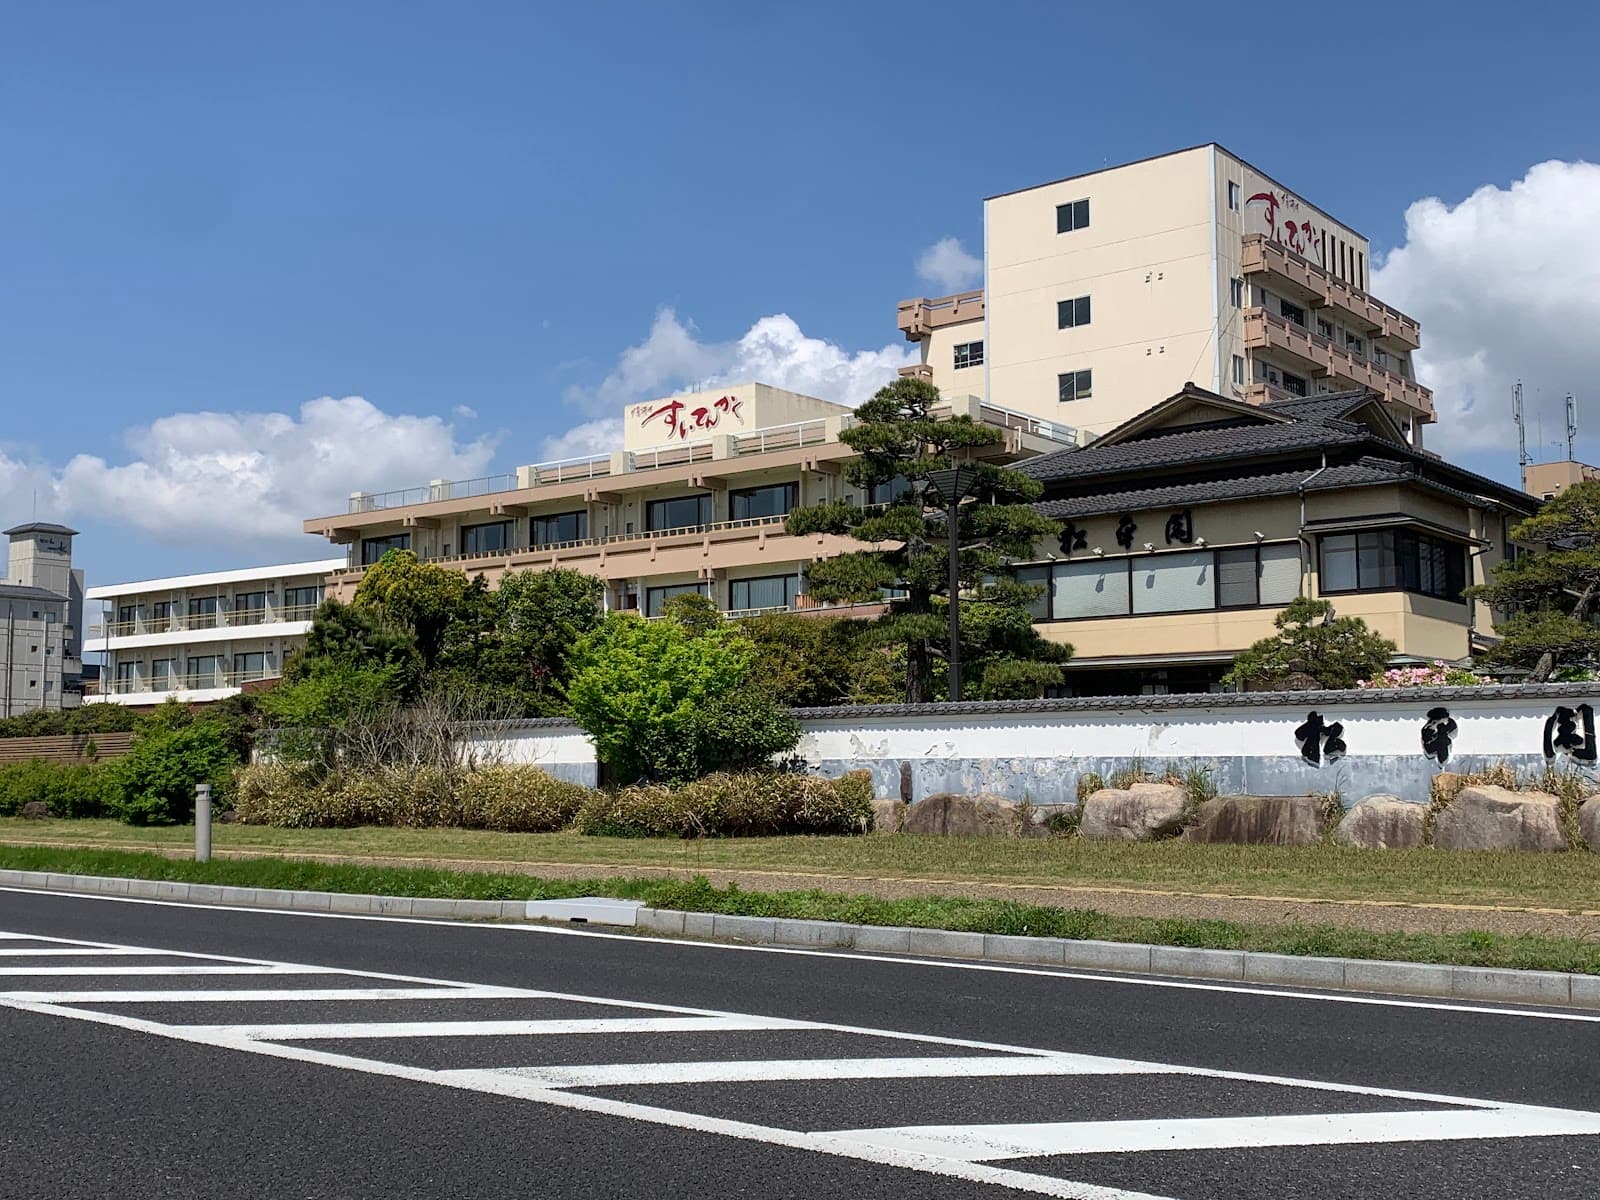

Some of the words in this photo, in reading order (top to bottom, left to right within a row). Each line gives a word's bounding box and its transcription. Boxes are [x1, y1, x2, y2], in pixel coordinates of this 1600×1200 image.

[641, 396, 744, 439] すいてんかく
